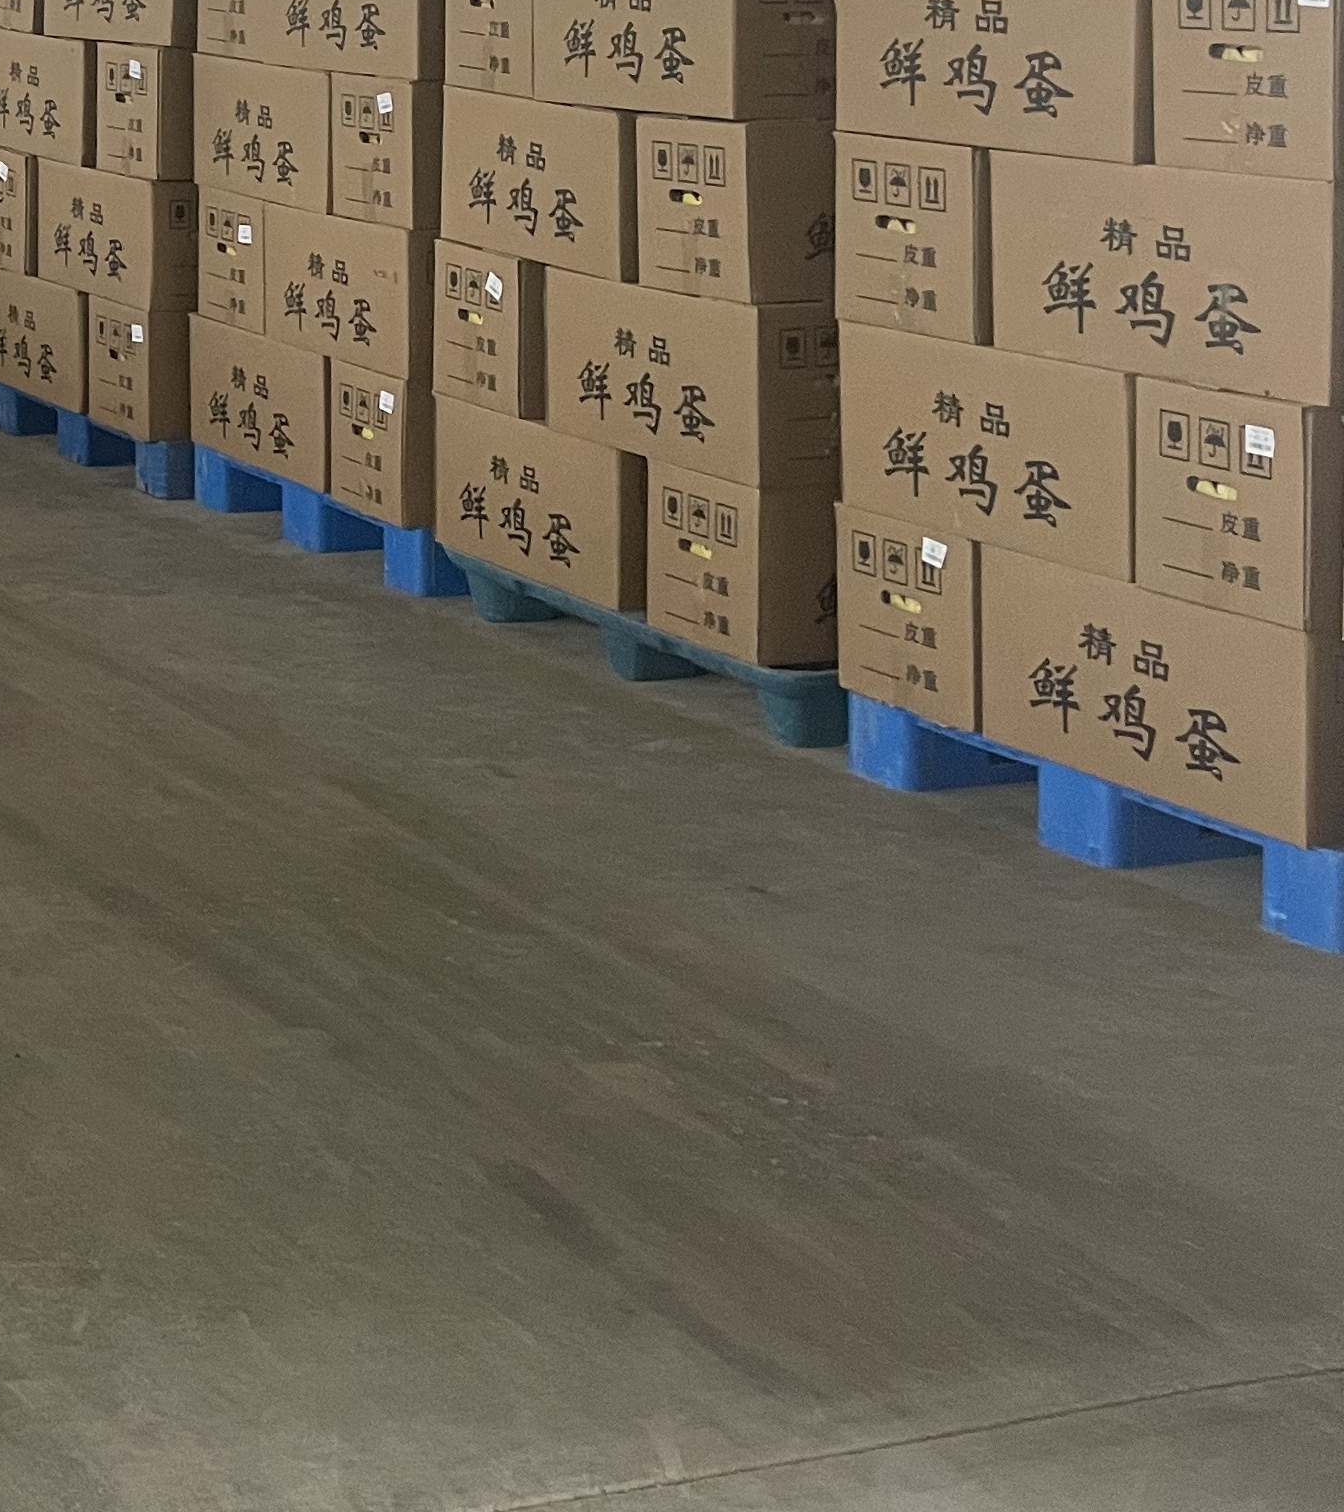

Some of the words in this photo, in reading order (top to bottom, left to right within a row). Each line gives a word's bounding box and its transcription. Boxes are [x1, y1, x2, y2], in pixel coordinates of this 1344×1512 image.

[563, 18, 695, 85] 鲜鸡蛋
[9, 60, 40, 87] 精品
[879, 37, 1075, 118] 鲜鸡蛋
[1244, 72, 1288, 100] 皮重
[235, 98, 273, 130] 精品
[496, 133, 547, 172] 精品
[1244, 122, 1288, 149] 净重
[212, 127, 300, 187] 鲜鸡蛋
[71, 196, 105, 226] 精品
[468, 167, 584, 243] 鲜鸡蛋
[54, 223, 129, 283] 鲜鸡蛋
[902, 243, 938, 269] 皮重
[1100, 216, 1192, 263] 精品
[308, 251, 349, 286] 精品
[7, 303, 37, 331] 精品
[283, 280, 377, 347] 鲜鸡蛋
[1041, 259, 1262, 355] 鲜鸡蛋
[614, 327, 671, 367] 精品
[231, 364, 269, 400] 精品
[577, 358, 716, 443] 鲜鸡蛋
[208, 391, 296, 461] 鲜鸡蛋
[932, 390, 1010, 439] 精品
[489, 454, 541, 495] 精品
[882, 426, 1073, 528] 鲜鸡蛋
[459, 481, 581, 569] 鲜鸡蛋
[1220, 510, 1263, 542] 皮重
[1220, 561, 1262, 592] 净重
[903, 621, 938, 651] 皮重
[1078, 623, 1170, 683] 精品
[905, 664, 939, 693] 净重
[1028, 657, 1242, 782] 鲜鸡蛋
